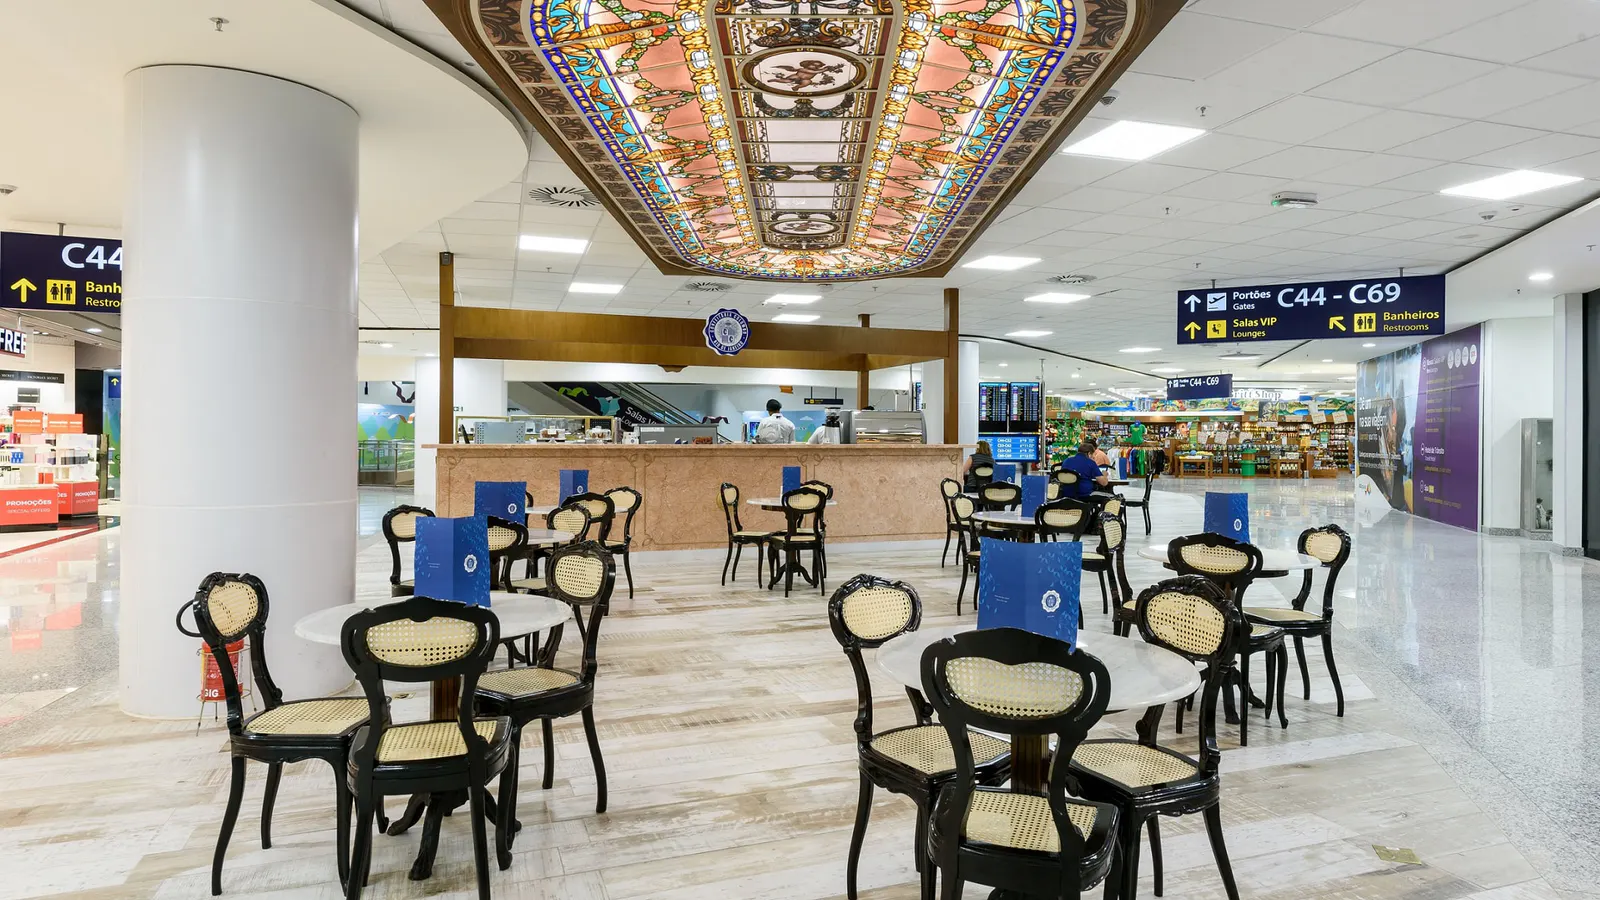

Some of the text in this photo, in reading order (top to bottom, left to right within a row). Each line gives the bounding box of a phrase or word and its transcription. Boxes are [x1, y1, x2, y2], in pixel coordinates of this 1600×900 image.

[61, 242, 122, 271] C44
[1232, 290, 1271, 300] Portões
[1277, 287, 1327, 308] C44
[1349, 282, 1401, 304] C69
[1232, 302, 1255, 311] Gates
[1383, 310, 1440, 321] Banheiros
[1232, 317, 1277, 328] Salas VIP
[1383, 323, 1430, 332] Restrooms
[1232, 330, 1266, 339] Lounges
[0, 327, 27, 354] FREE
[1189, 378, 1202, 387] C44
[1206, 376, 1219, 386] C69
[625, 406, 647, 424] Salas
